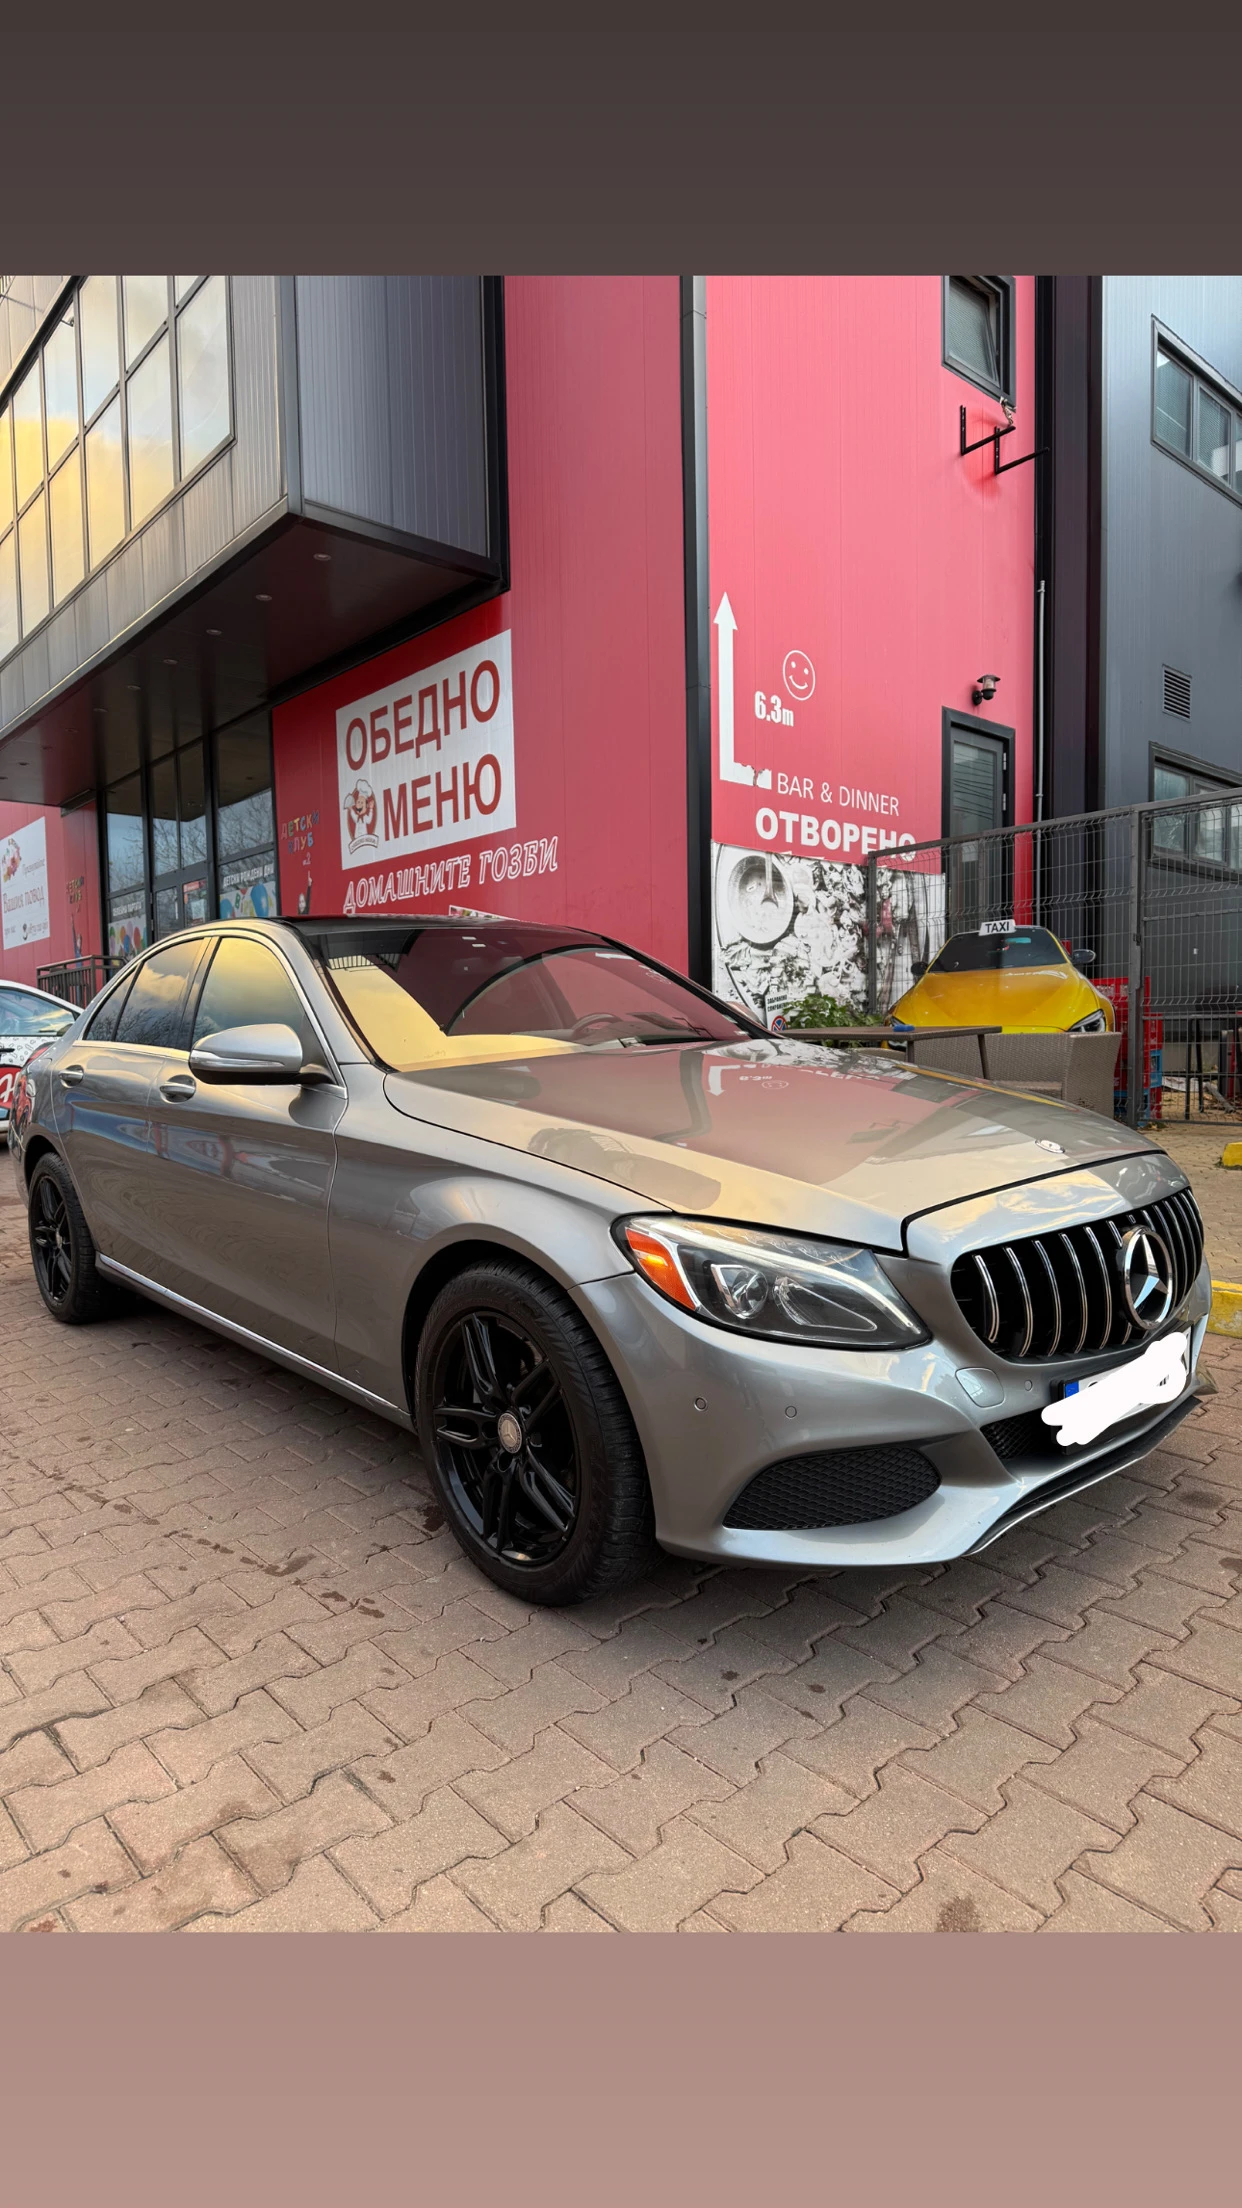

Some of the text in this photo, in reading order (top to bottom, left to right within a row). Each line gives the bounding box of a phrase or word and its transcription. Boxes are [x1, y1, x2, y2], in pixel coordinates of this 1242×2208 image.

[345, 660, 500, 770] ОБЕДНО
[754, 691, 794, 727] 6.3m
[383, 753, 502, 842] МЕНЮ
[777, 773, 900, 816] BAR & DINNER
[281, 810, 319, 840] ДЕТСКИ
[287, 832, 314, 854] КЛУБ
[755, 807, 917, 862] ОТВОРЕНО
[343, 836, 558, 914] ДОМАШНИТЕ ГОЗБИ
[985, 921, 1010, 933] TAXI
